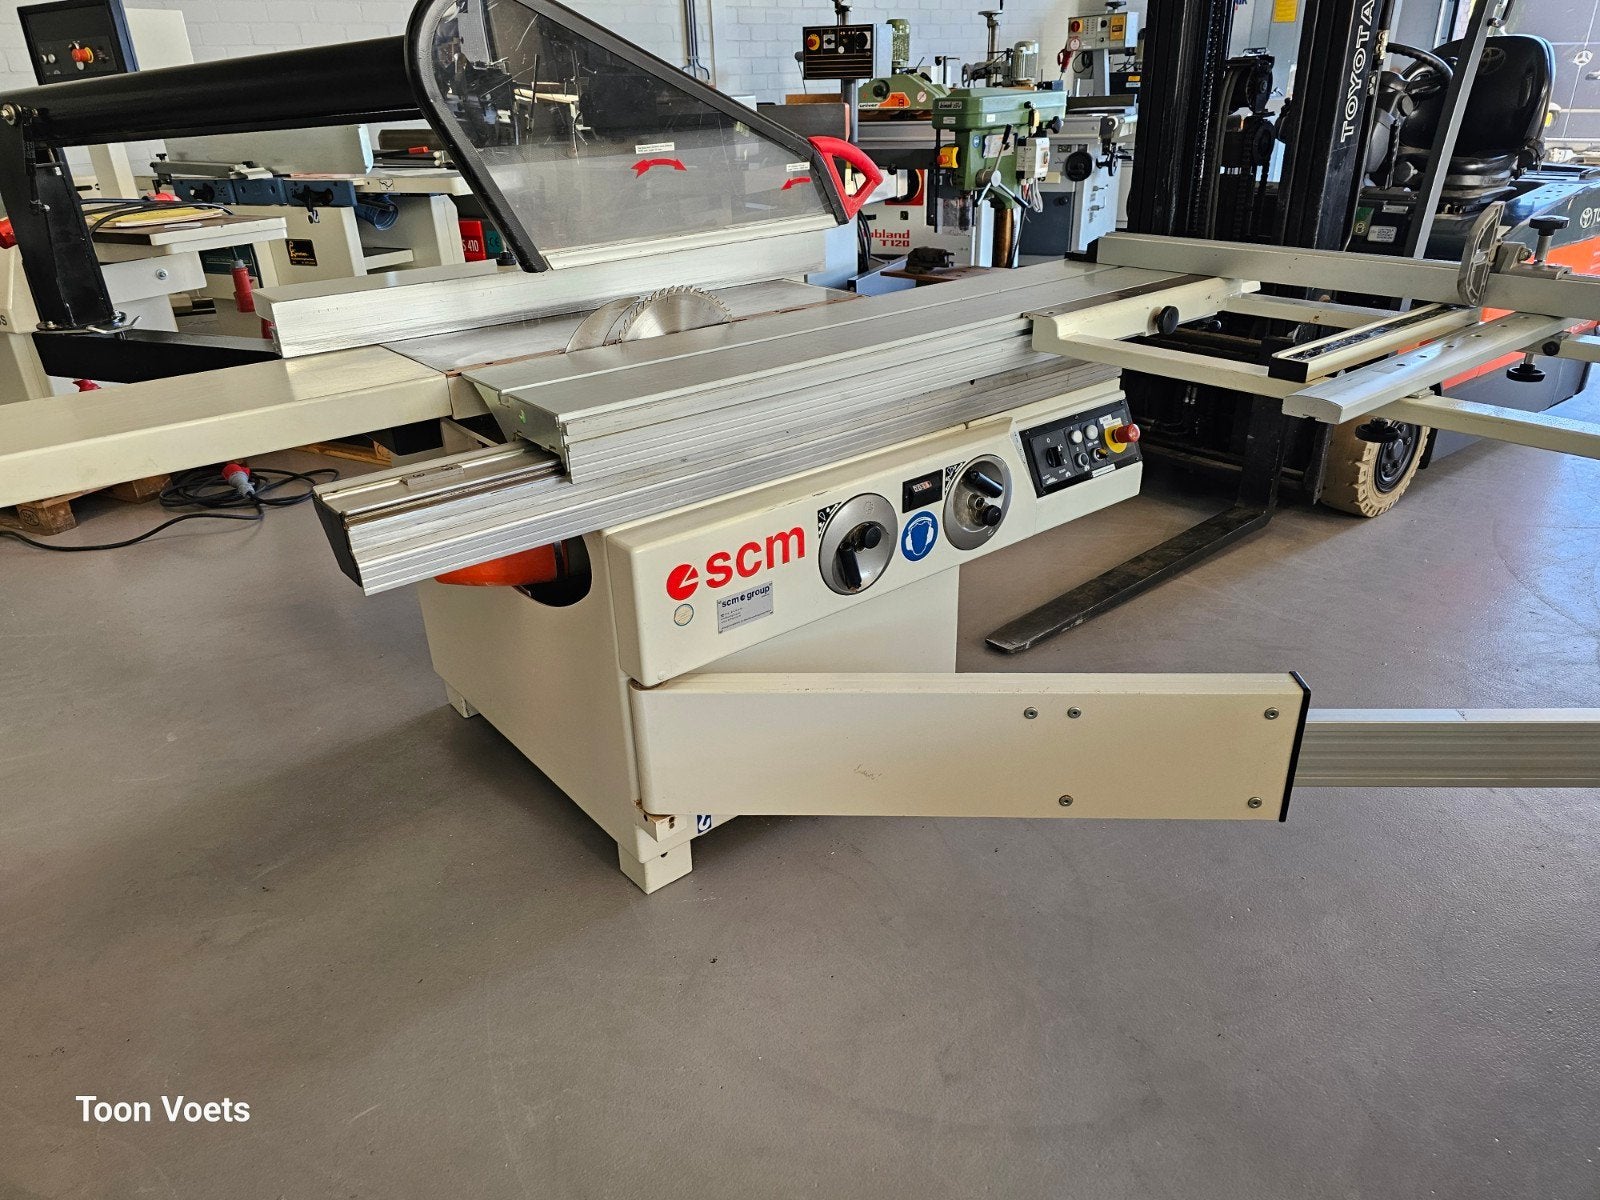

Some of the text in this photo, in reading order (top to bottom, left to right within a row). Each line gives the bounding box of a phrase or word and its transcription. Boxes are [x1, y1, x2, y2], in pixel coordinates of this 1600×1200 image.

[1341, 0, 1375, 143] TOYOTA
[705, 526, 806, 589] scm
[721, 585, 770, 608] scm group
